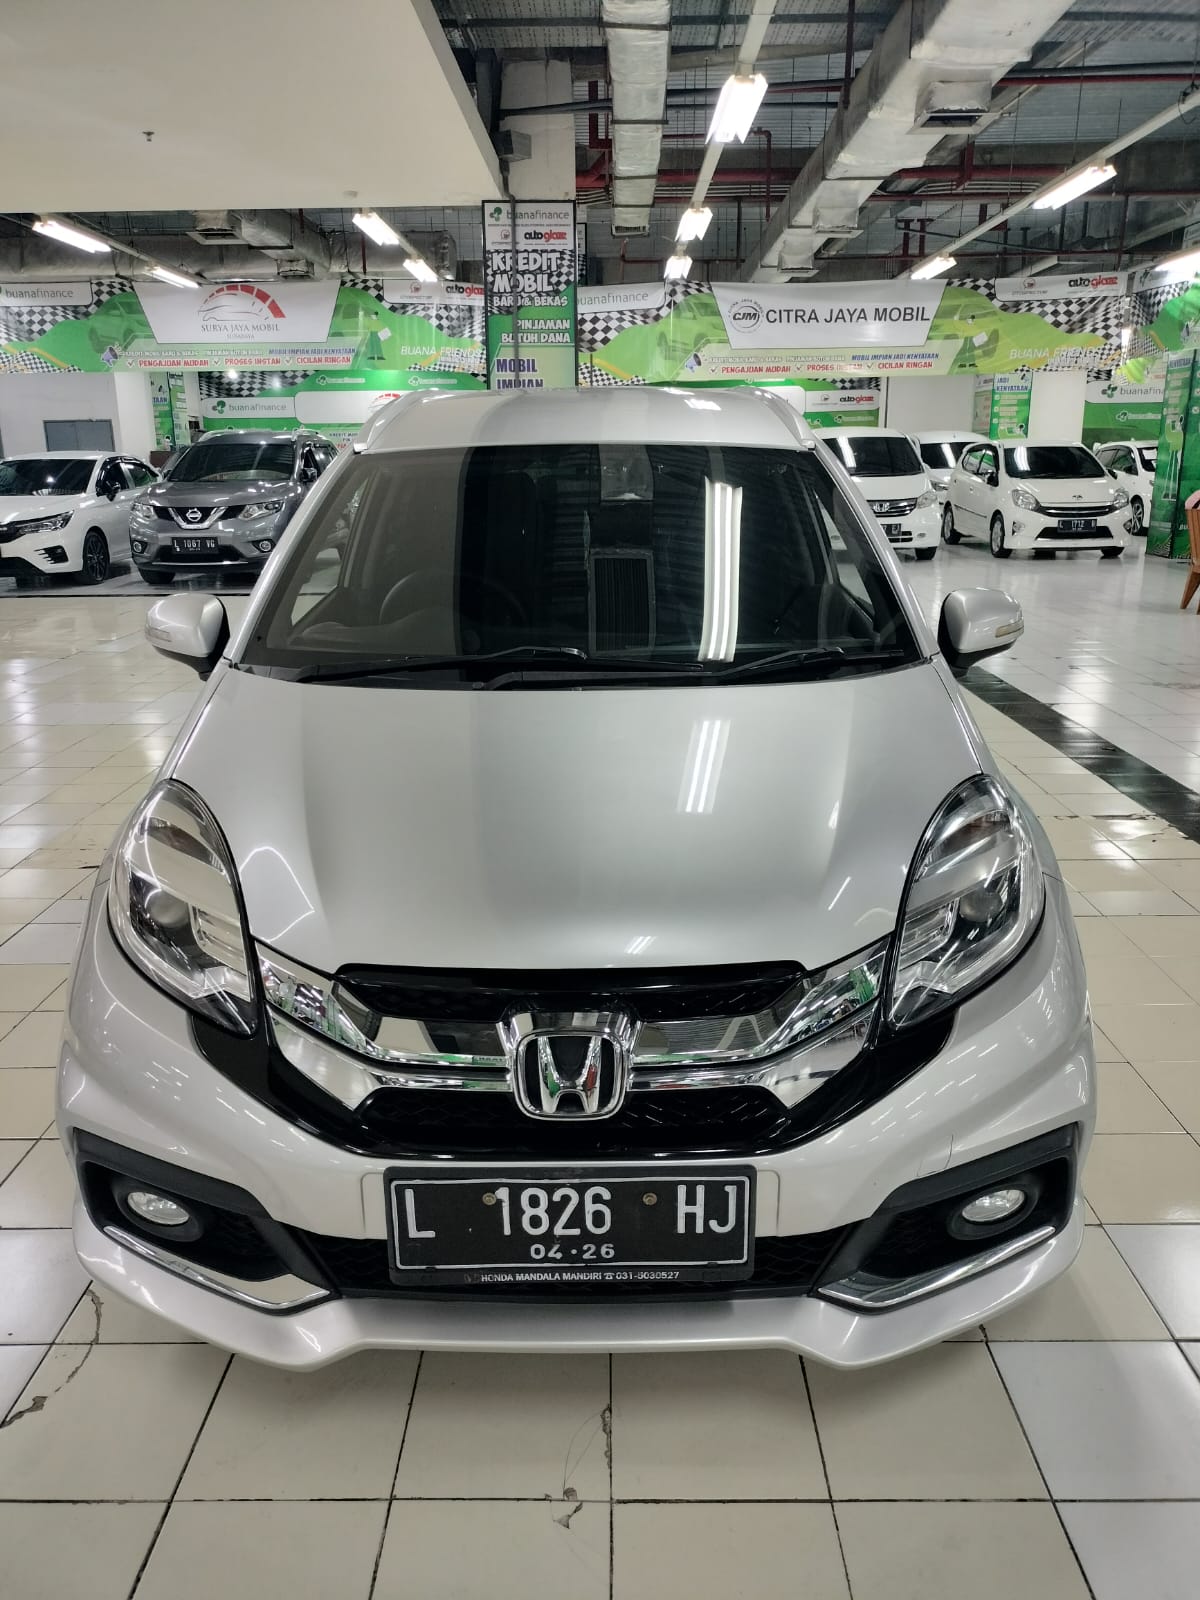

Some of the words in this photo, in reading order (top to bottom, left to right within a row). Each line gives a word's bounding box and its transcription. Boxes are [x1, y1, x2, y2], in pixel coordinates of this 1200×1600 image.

[507, 209, 569, 220] buanafinance
[524, 230, 567, 242] autoglaze
[492, 252, 561, 271] KREDIT
[493, 273, 553, 293] MOBIL
[1068, 275, 1118, 289] autoglaze
[6, 288, 74, 298] buanafinance
[446, 284, 486, 297] autoglaz
[534, 296, 568, 307] BEKAS
[733, 312, 758, 321] CJM
[766, 308, 819, 324] CITRA
[824, 308, 868, 323] JAYA
[873, 306, 930, 322] MOBIL
[201, 323, 228, 332] SURYA
[231, 324, 249, 332] JAYA
[252, 323, 280, 332] MOBIL
[501, 332, 538, 343] BUTUH
[541, 332, 571, 343] DANA
[401, 345, 437, 355] BUANA
[496, 358, 538, 373] MOBIL
[721, 365, 763, 374] PENGAJUAN
[765, 365, 791, 373] MUDAH
[807, 363, 834, 371] PROSES
[878, 361, 904, 370] CICILAN
[906, 360, 933, 369] RINGAN
[1120, 386, 1164, 396] buanafin
[229, 403, 288, 412] buanafinance
[404, 1188, 436, 1239] L
[494, 1185, 613, 1236] 1826
[676, 1184, 738, 1234] HJ
[481, 1273, 514, 1282] HONDA
[515, 1272, 561, 1281] MANDALA
[562, 1271, 602, 1281] MANDIRI
